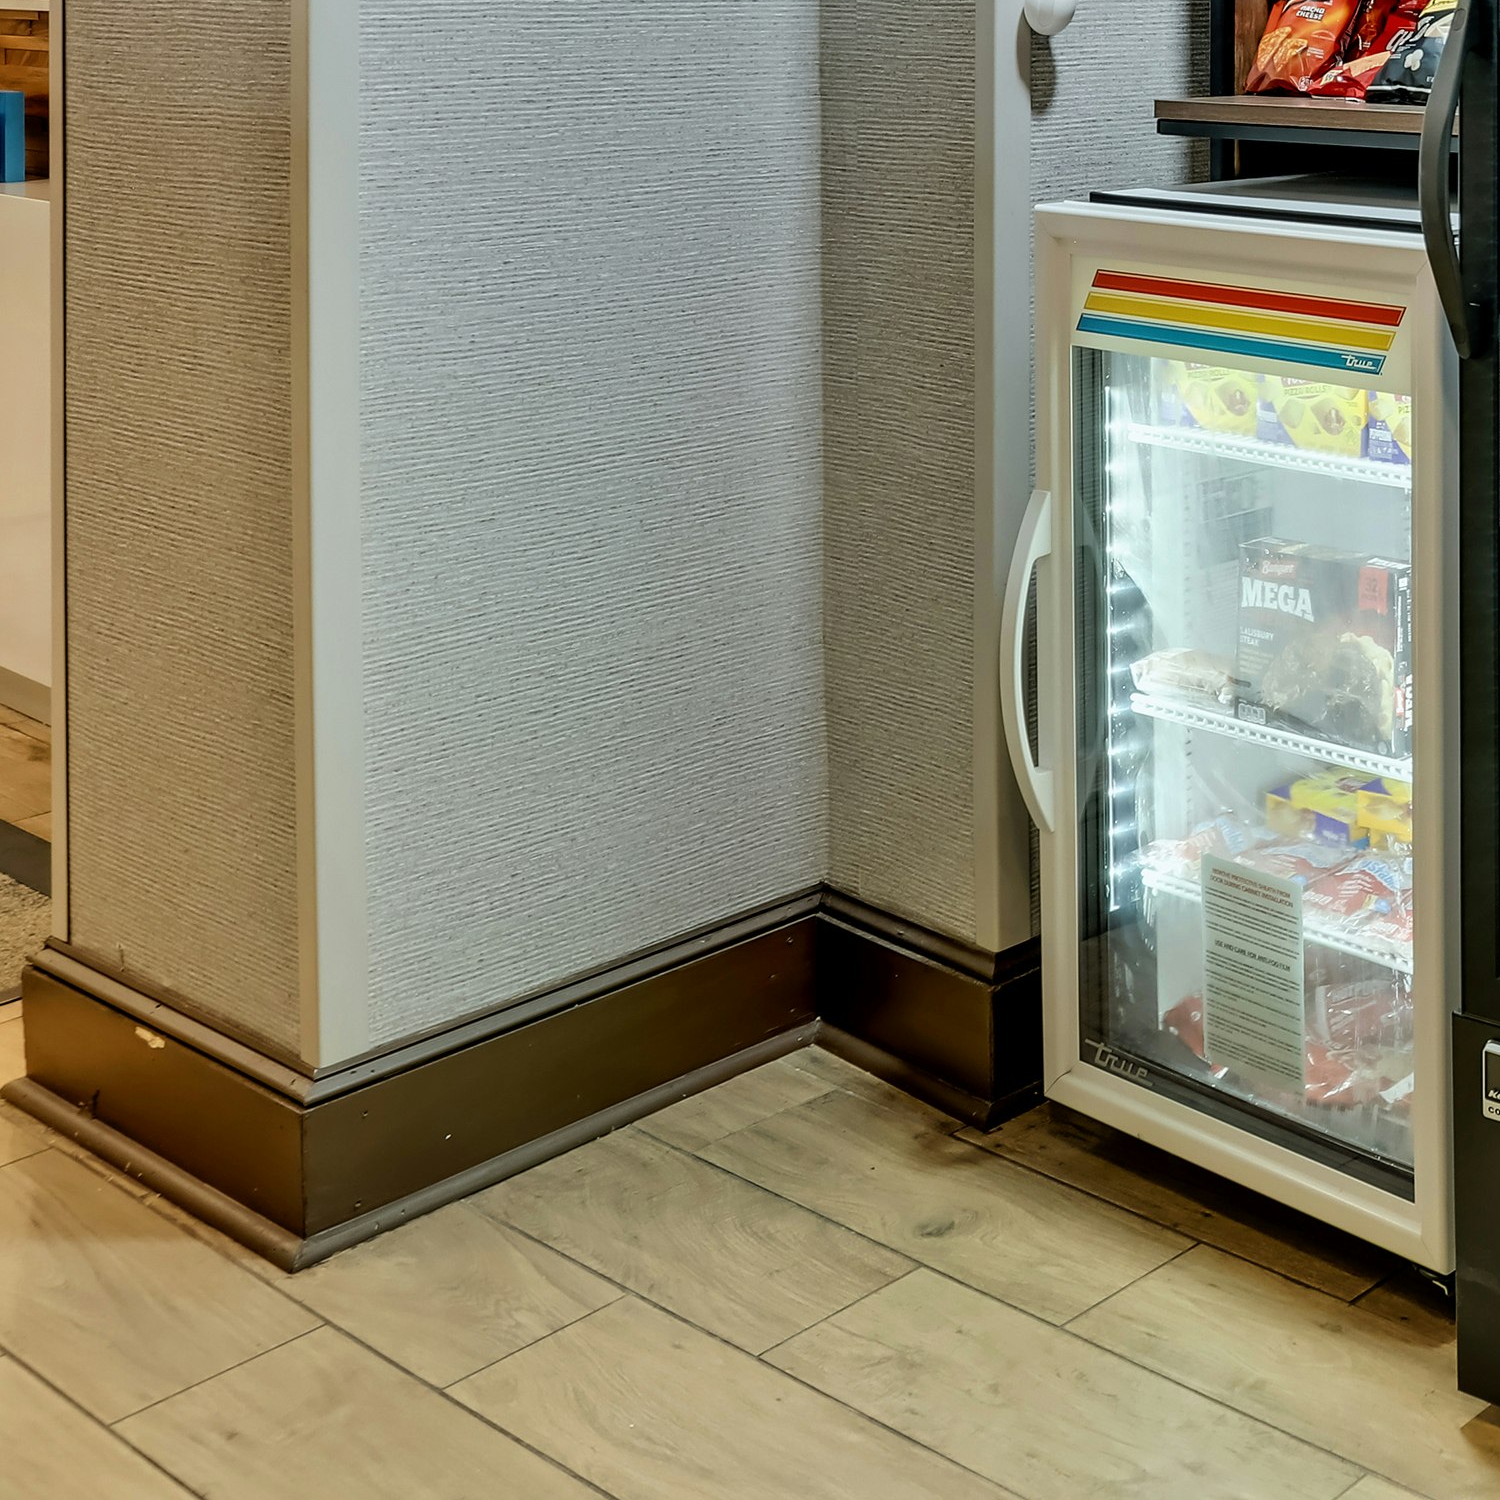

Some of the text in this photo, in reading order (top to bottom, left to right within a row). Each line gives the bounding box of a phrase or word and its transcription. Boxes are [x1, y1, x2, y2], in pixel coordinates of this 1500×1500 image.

[1296, 11, 1324, 21] CHEESE
[1341, 354, 1376, 370] true
[1241, 576, 1315, 623] MEGA
[1085, 1038, 1153, 1087] true
